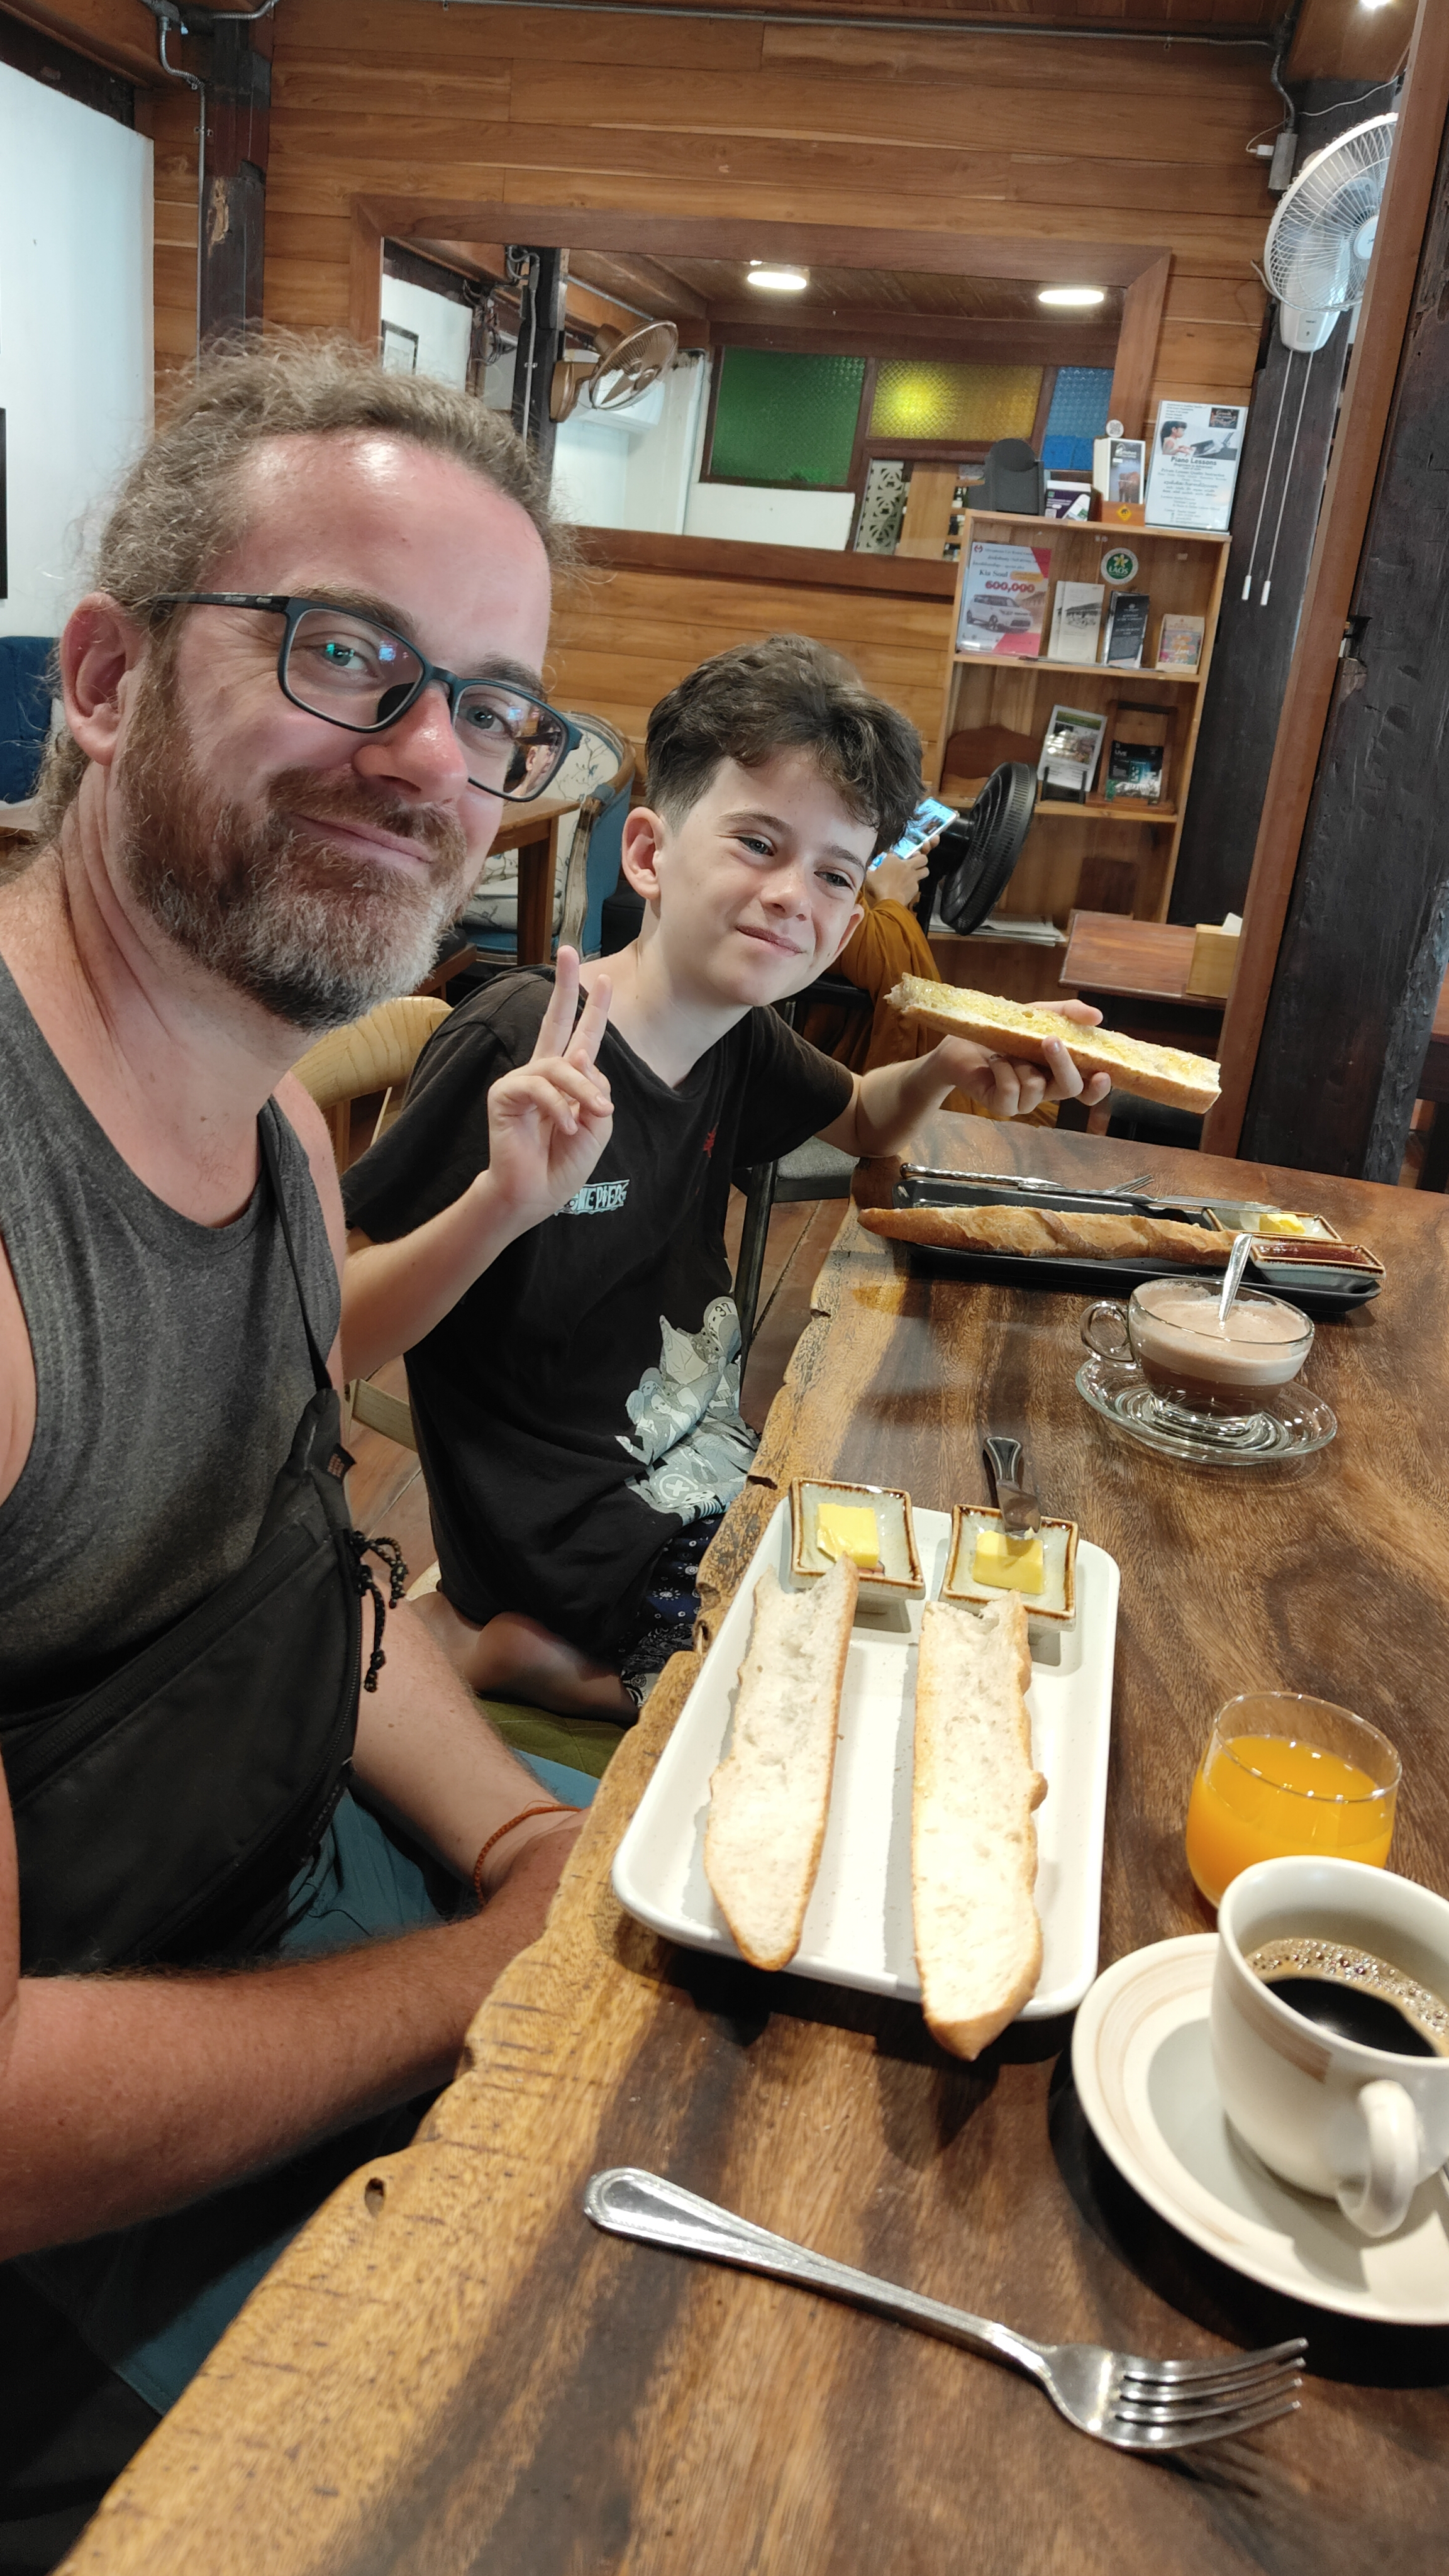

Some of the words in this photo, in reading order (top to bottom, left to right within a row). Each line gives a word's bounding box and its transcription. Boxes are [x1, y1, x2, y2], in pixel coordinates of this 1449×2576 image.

[1191, 457, 1217, 465] Lessons
[1109, 565, 1129, 574] LAOS
[985, 580, 1035, 593] 600,000
